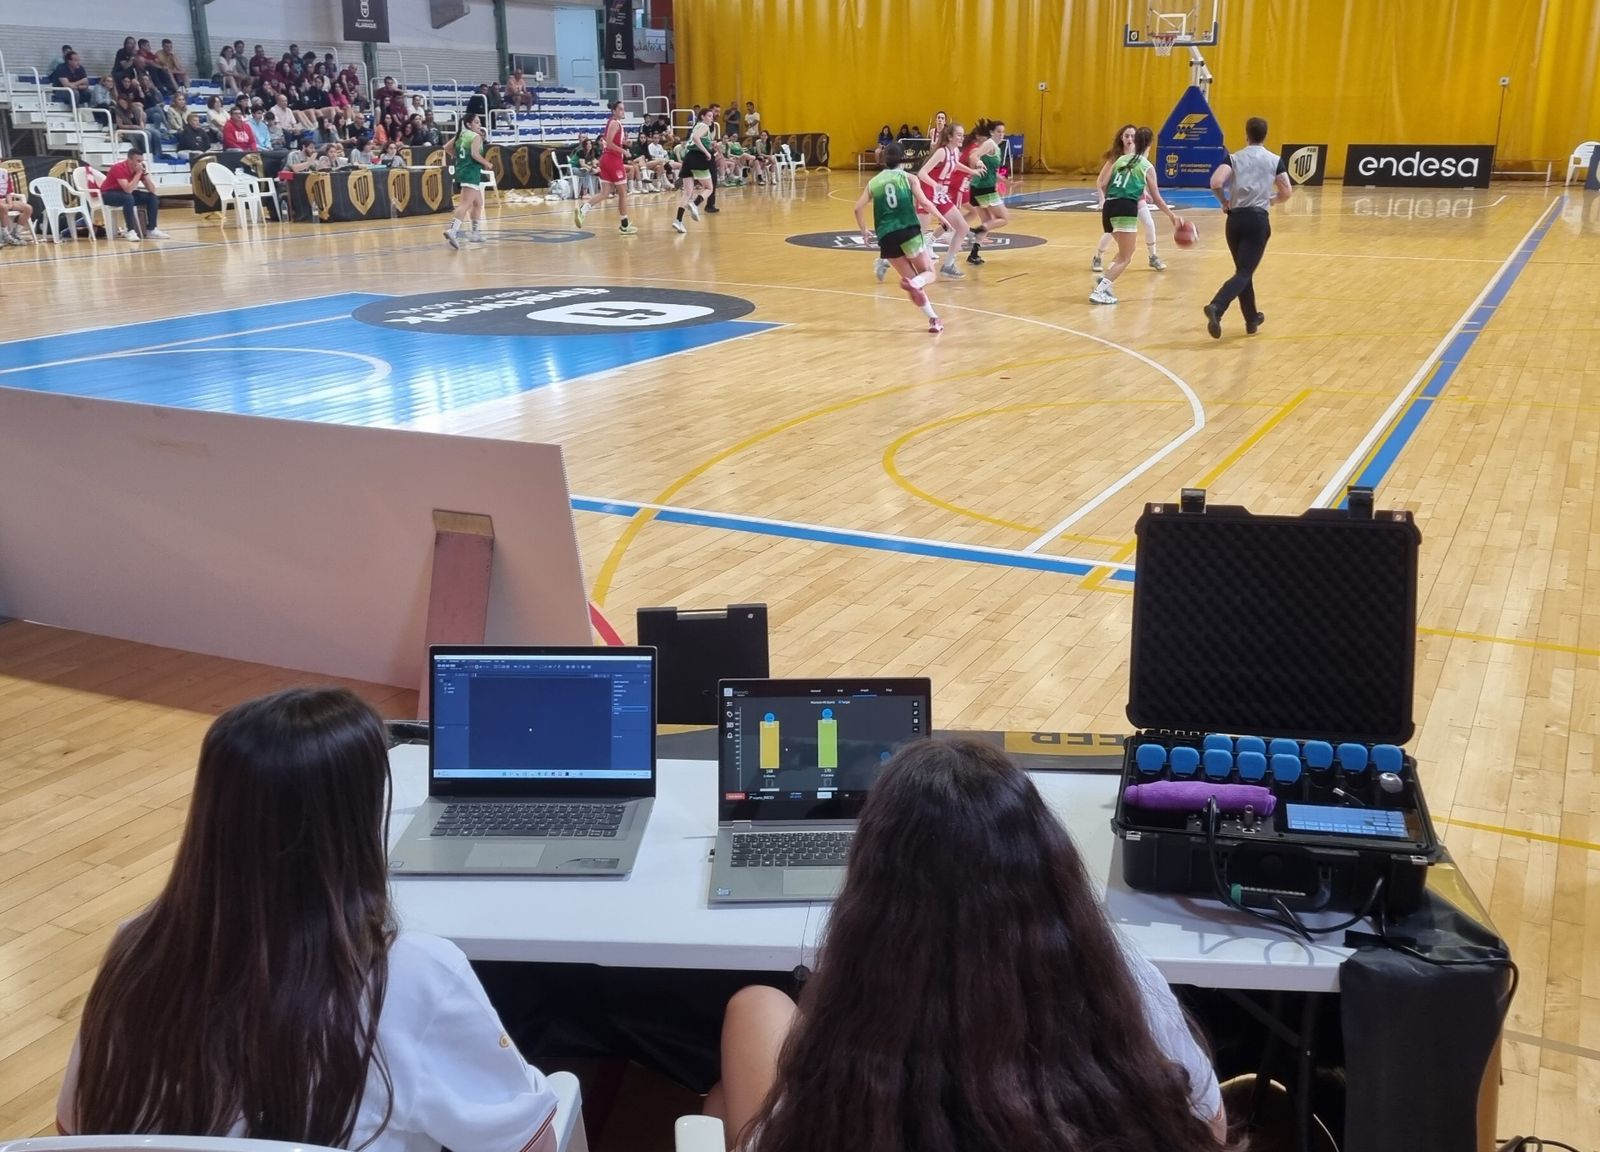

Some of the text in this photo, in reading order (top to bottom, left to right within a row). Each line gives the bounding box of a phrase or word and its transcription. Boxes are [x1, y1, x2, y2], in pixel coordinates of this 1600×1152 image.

[1294, 153, 1312, 177] 100
[1358, 151, 1479, 177] endesa
[353, 174, 370, 206] 100
[393, 174, 406, 202] 100
[425, 174, 439, 202] 100
[1113, 170, 1131, 189] 41
[884, 183, 898, 209] 8
[383, 287, 611, 325] finetwork
